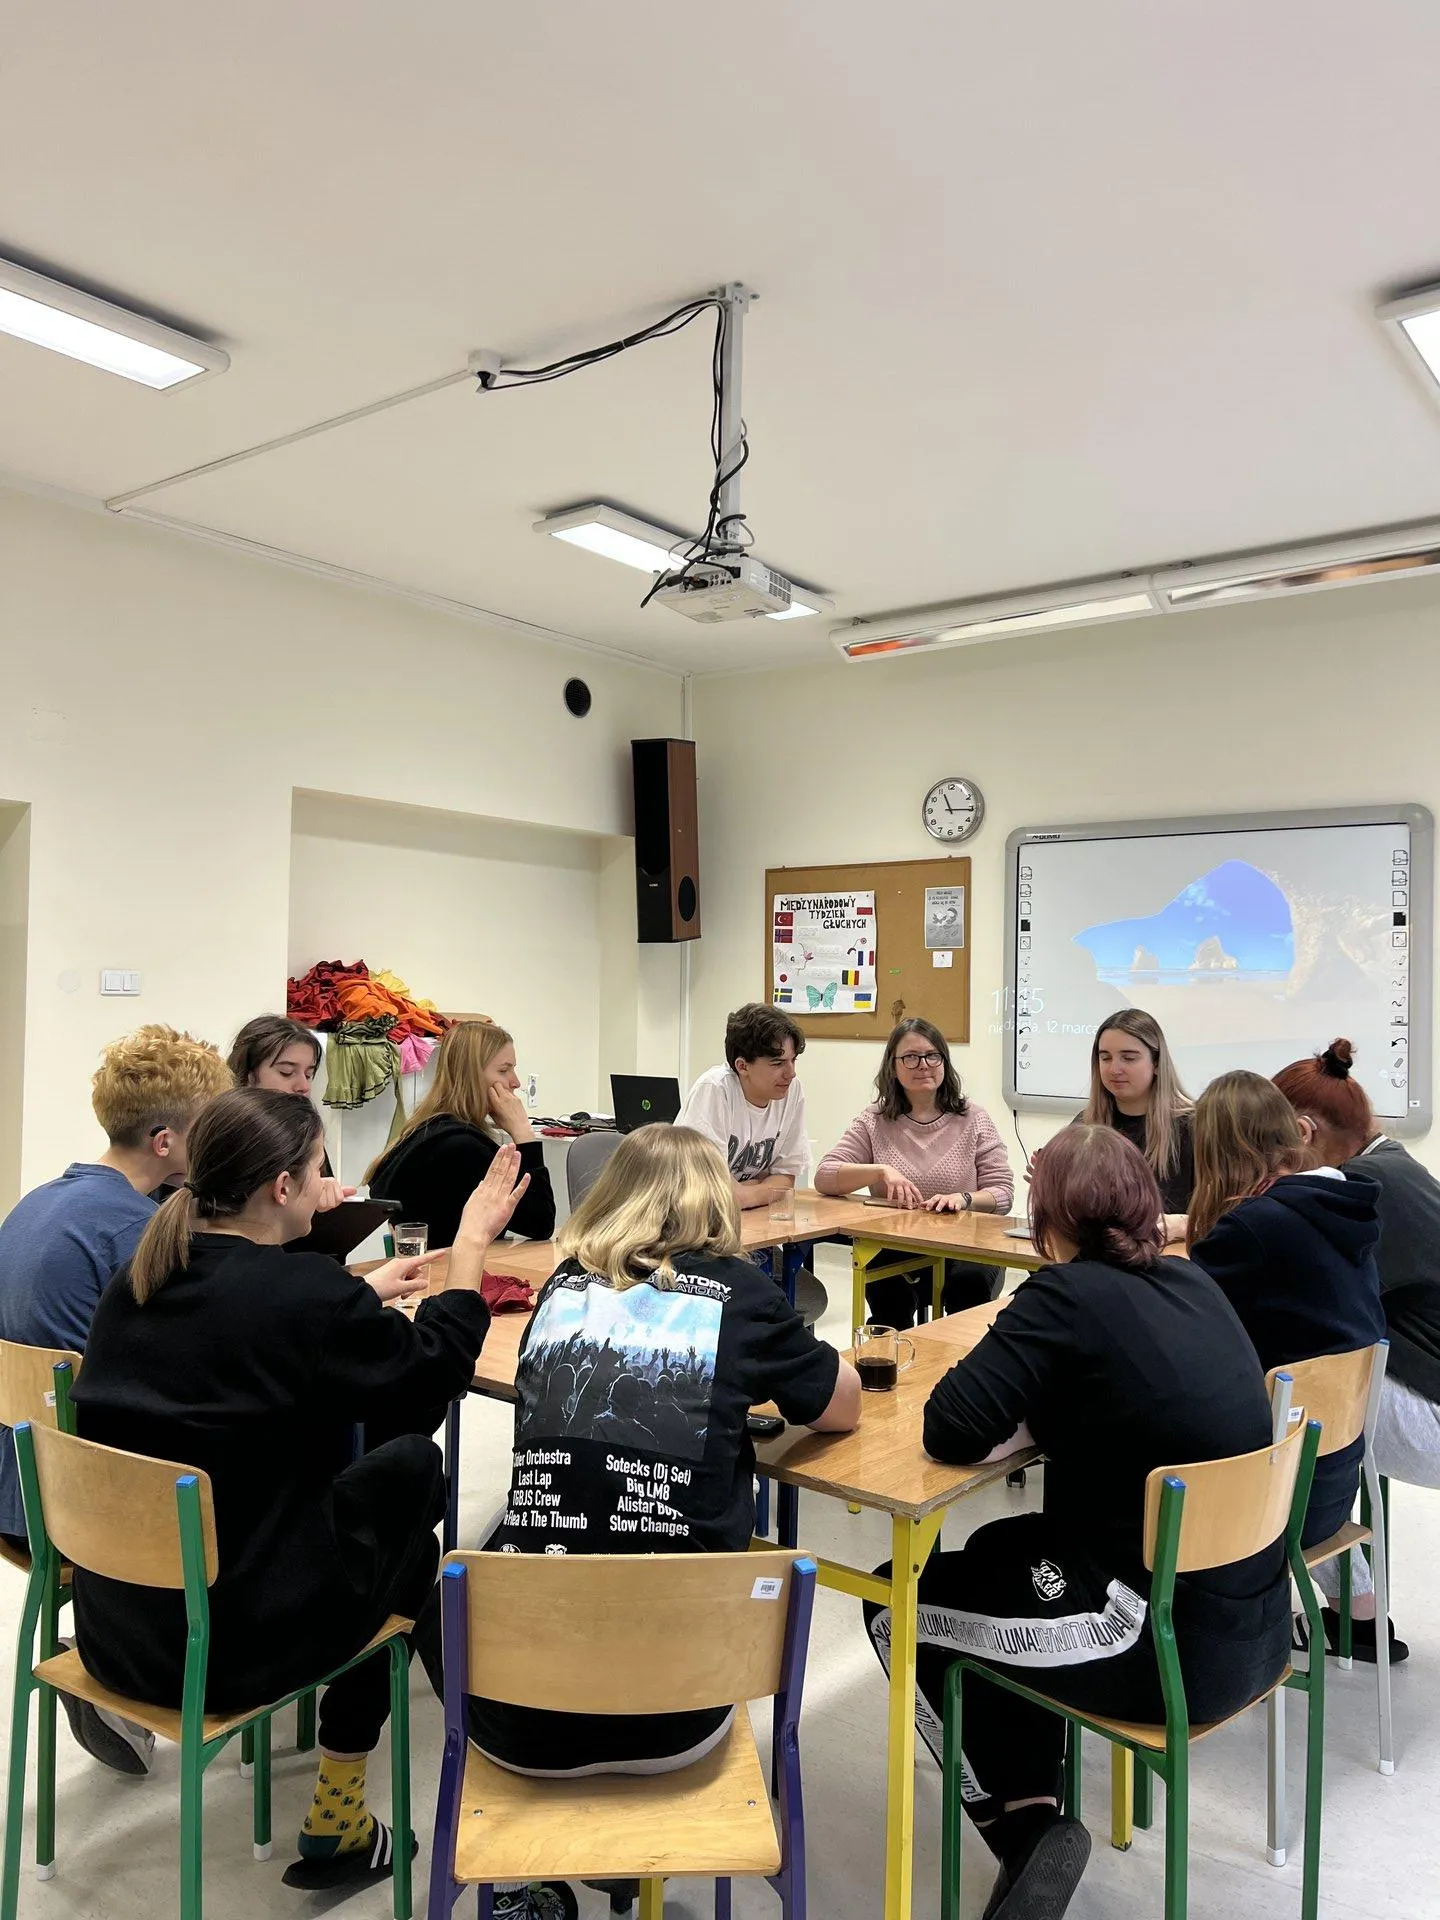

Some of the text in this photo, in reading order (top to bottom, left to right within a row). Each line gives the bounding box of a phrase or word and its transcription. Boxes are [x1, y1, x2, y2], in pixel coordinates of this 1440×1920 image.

[822, 919, 867, 929] GŁUCHYCH
[526, 1448, 571, 1466] Orchestra
[518, 1469, 552, 1490] Last Lap
[605, 1454, 692, 1487] Sotecks (Dj Set)
[534, 1489, 561, 1507] Crew
[626, 1477, 670, 1501] Big LM8
[616, 1495, 655, 1514] Alistar
[521, 1511, 528, 1527] &
[530, 1510, 547, 1527] The
[549, 1510, 588, 1529] Thumb
[609, 1514, 690, 1537] Slow Changes
